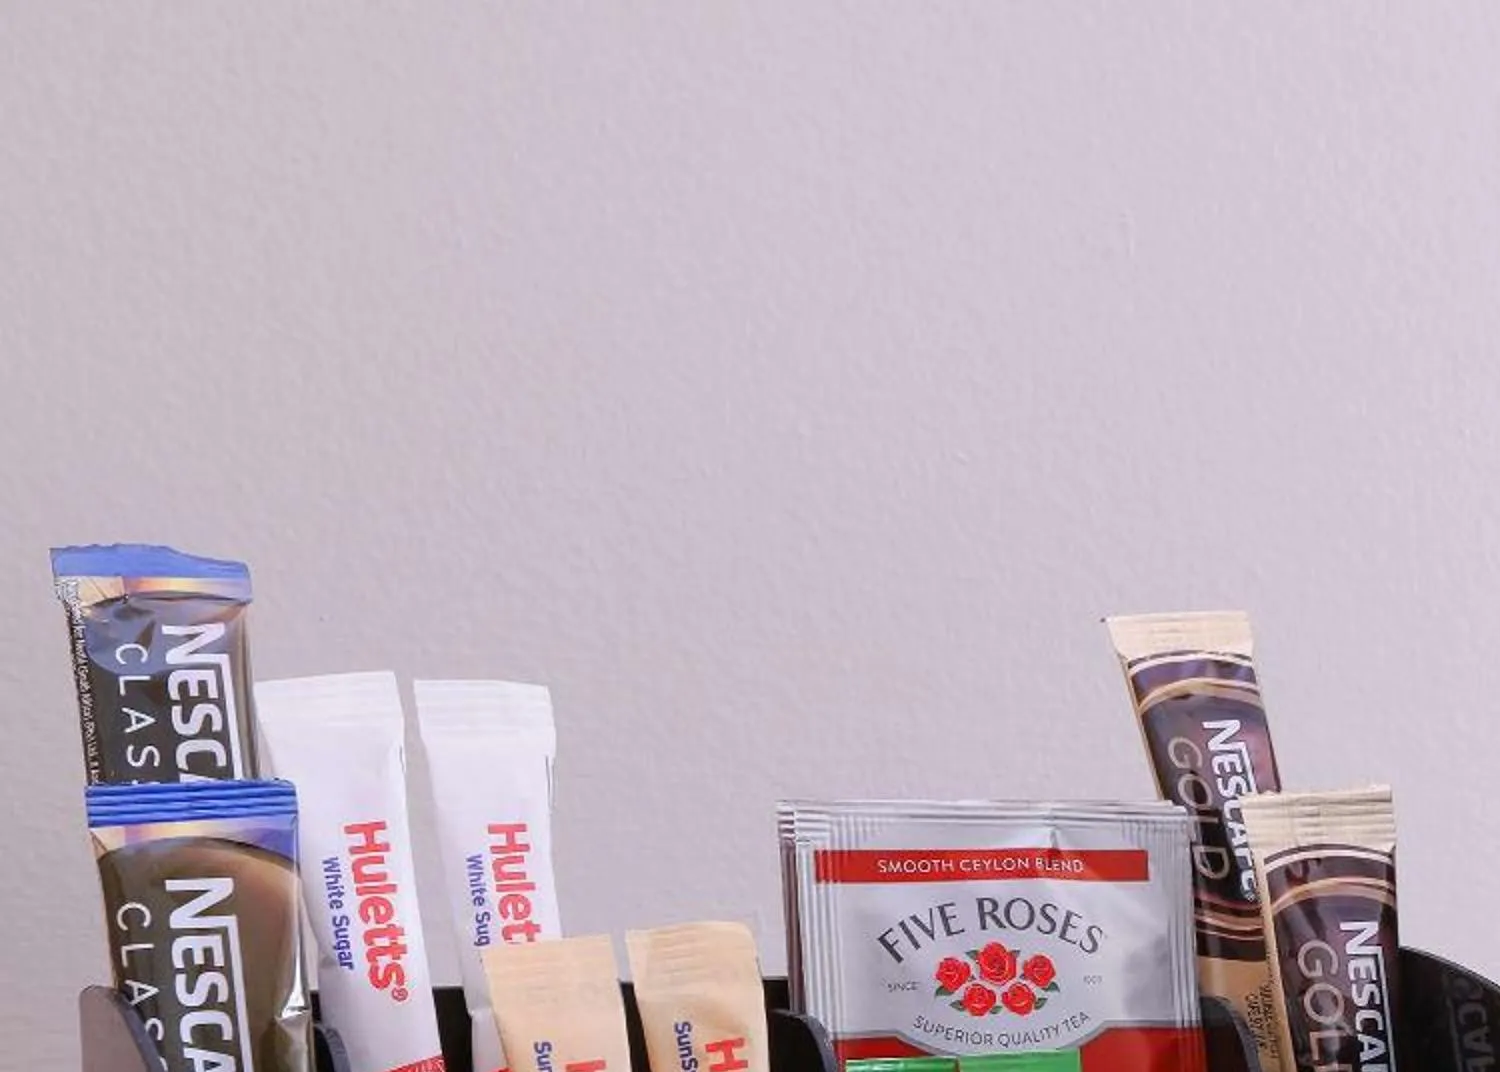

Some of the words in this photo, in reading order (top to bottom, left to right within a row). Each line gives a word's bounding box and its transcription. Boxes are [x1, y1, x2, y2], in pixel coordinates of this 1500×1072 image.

[162, 623, 244, 784] NESC
[1169, 737, 1229, 880] GOLD
[466, 855, 486, 907] White
[488, 824, 541, 945] Hulet
[878, 858, 954, 874] SMOOTH
[960, 857, 1030, 873] CEYLON
[1035, 856, 1084, 873] BLEND
[320, 857, 344, 909] White
[332, 914, 355, 970] Sugar
[474, 911, 491, 946] Sug
[877, 902, 966, 963] FIVE
[976, 897, 1103, 955] ROSES
[913, 1015, 994, 1045] SUPERIOR
[998, 1025, 1060, 1048] QUALITY
[1064, 1011, 1091, 1031] TEA
